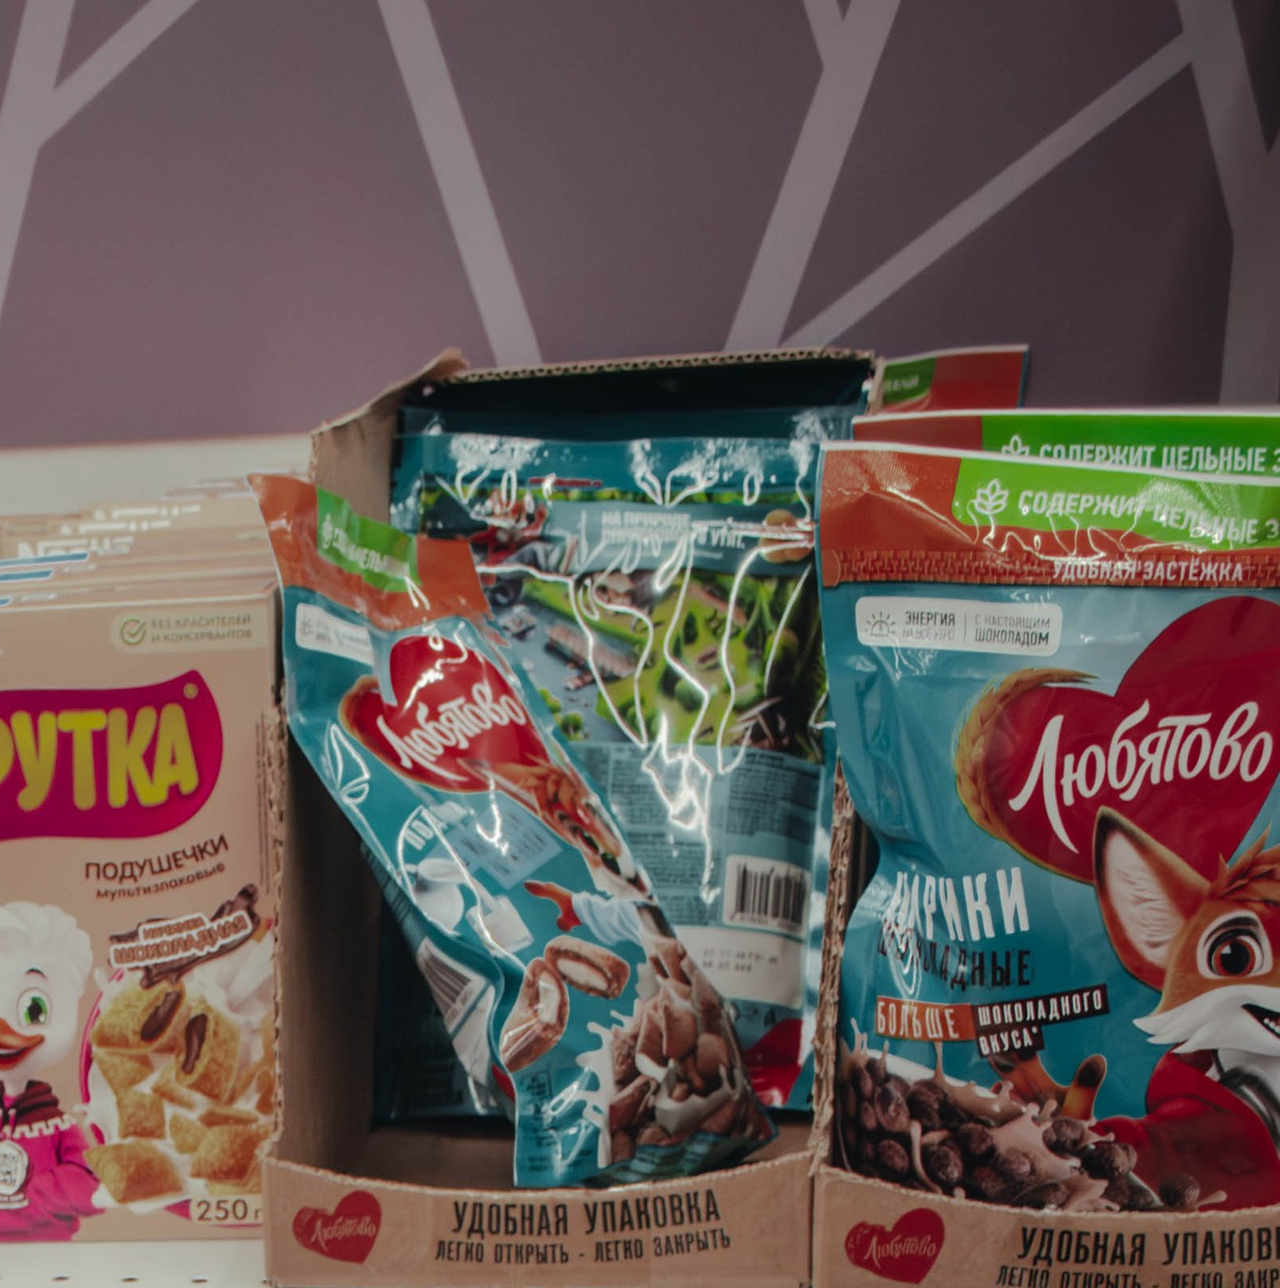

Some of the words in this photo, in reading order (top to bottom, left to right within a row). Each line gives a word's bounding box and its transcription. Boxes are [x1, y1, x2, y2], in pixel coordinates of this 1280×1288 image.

[1039, 444, 1153, 471] СОДЕРЖИТ
[1162, 446, 1266, 473] ЦЕЛЬНЫЕ
[1018, 490, 1147, 516] СОДЕРЖИТ
[1153, 503, 1257, 544] ЦЕЛЬНЫЕ
[1052, 559, 1137, 582] УДОБНАЯ
[1142, 557, 1244, 582] ЗАСТЁЖКА
[162, 628, 253, 643] КОНСЕРВАНТОВ
[175, 614, 252, 629] КРАСИТЕЛЕЙ
[904, 610, 955, 627] ЭНЕРГИЯ
[985, 615, 1051, 630] НАСТОЯЩИМ
[974, 629, 1050, 647] ШОКОЛАДОМ
[377, 684, 526, 781] Любятово
[1008, 699, 1273, 854] Любятово
[85, 834, 229, 882] ПОДУШЕЧКИ
[96, 862, 226, 901] мультизлаковые
[113, 913, 249, 964] ШОКОЛАДНАЯ
[876, 1001, 960, 1040] БОЛЬШЕ
[977, 990, 1103, 1027] ШОКОЛАДНОГО
[196, 1199, 248, 1221] 250
[453, 1201, 568, 1239] УДОБНАЯ
[583, 1189, 721, 1236] УПАКОВКА
[434, 1239, 484, 1263] ЛЕГКО
[494, 1241, 569, 1264] ОТКРЫТЬ
[594, 1239, 644, 1263] ЛЕГКО
[654, 1228, 731, 1260] ЗАКРЫТЬ
[1016, 1226, 1146, 1267] УДОБНАЯ
[995, 1265, 1050, 1288] ЛЕГКО
